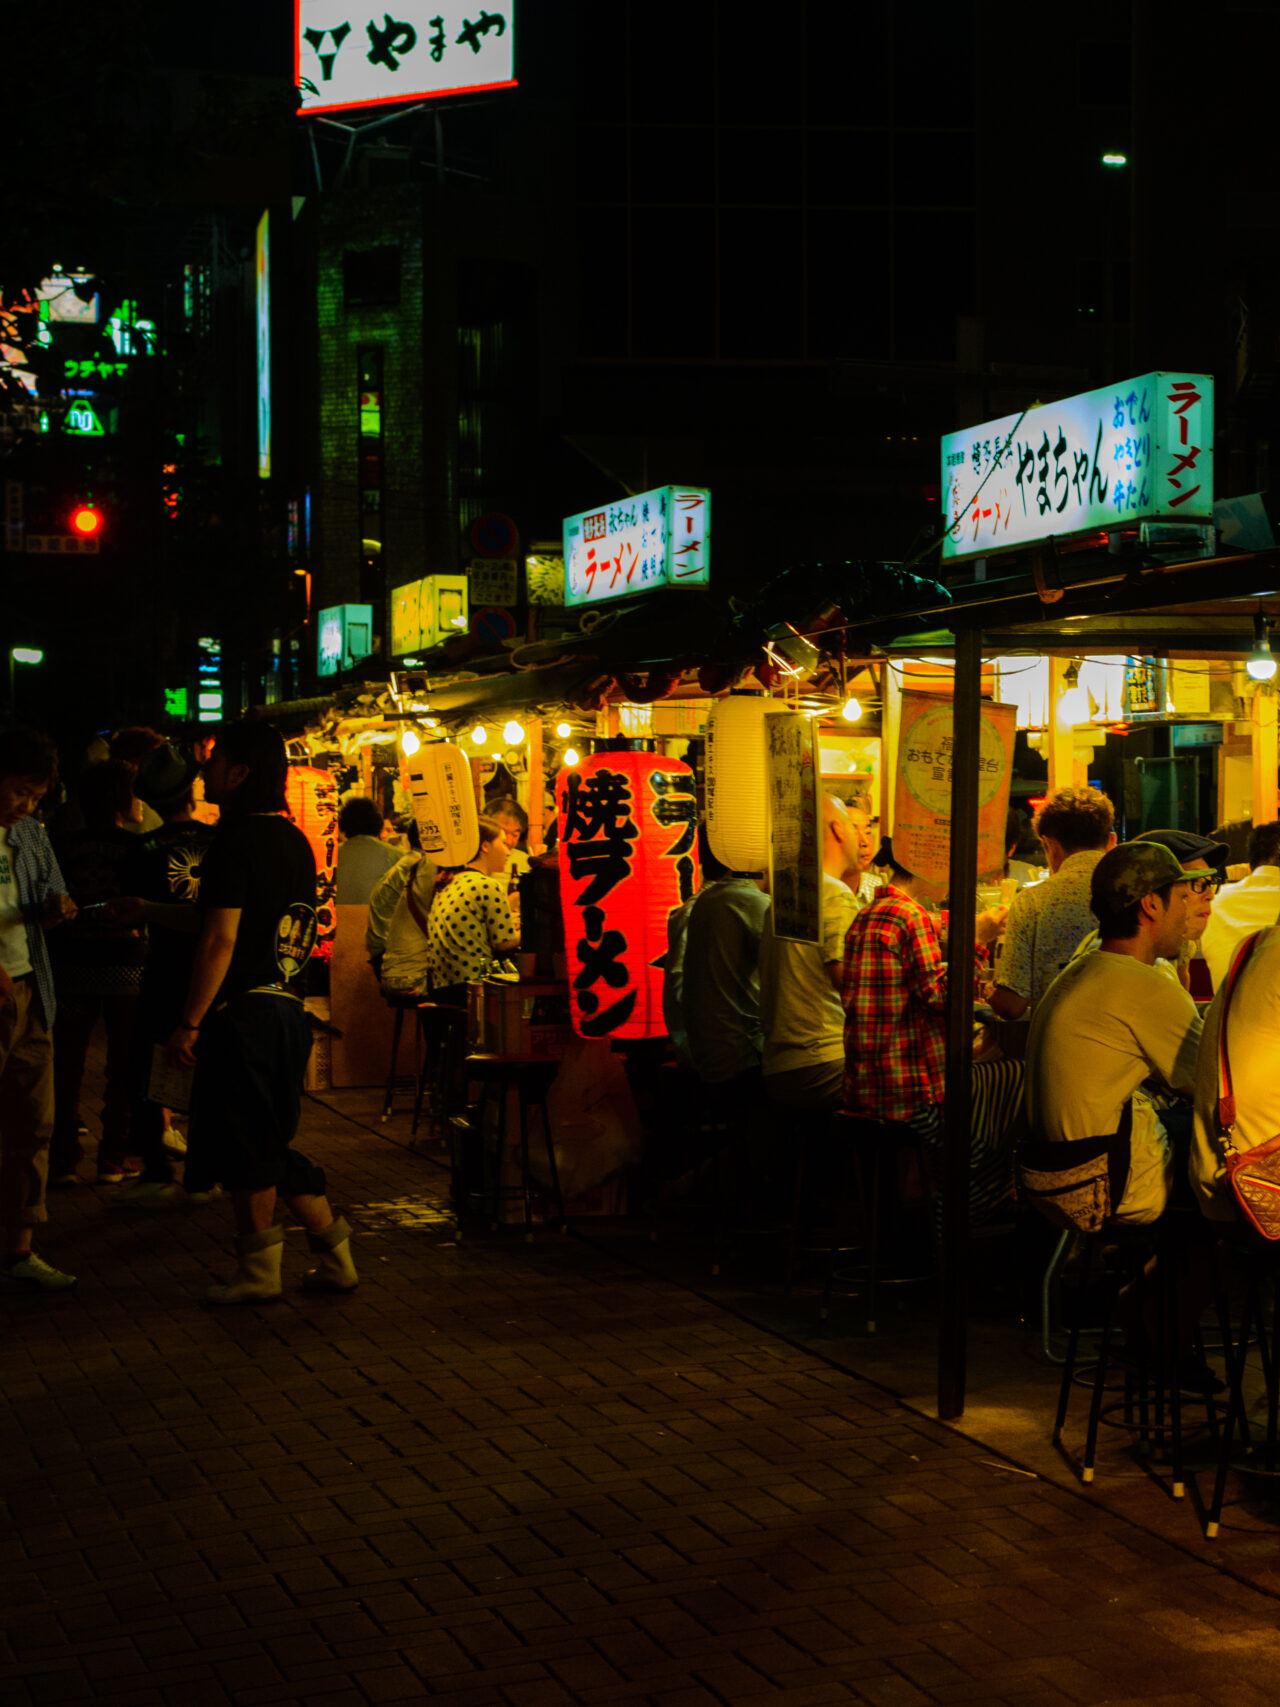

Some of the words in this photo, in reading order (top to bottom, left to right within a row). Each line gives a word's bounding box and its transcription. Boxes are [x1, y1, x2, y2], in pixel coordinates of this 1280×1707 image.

[366, 10, 507, 72] やまや
[1015, 418, 1108, 516] やまちゃん
[1166, 382, 1202, 508] ラーメン
[585, 543, 640, 595] ラーメン
[672, 494, 705, 578] ラーメン
[562, 770, 639, 1037] 焼ラーメン
